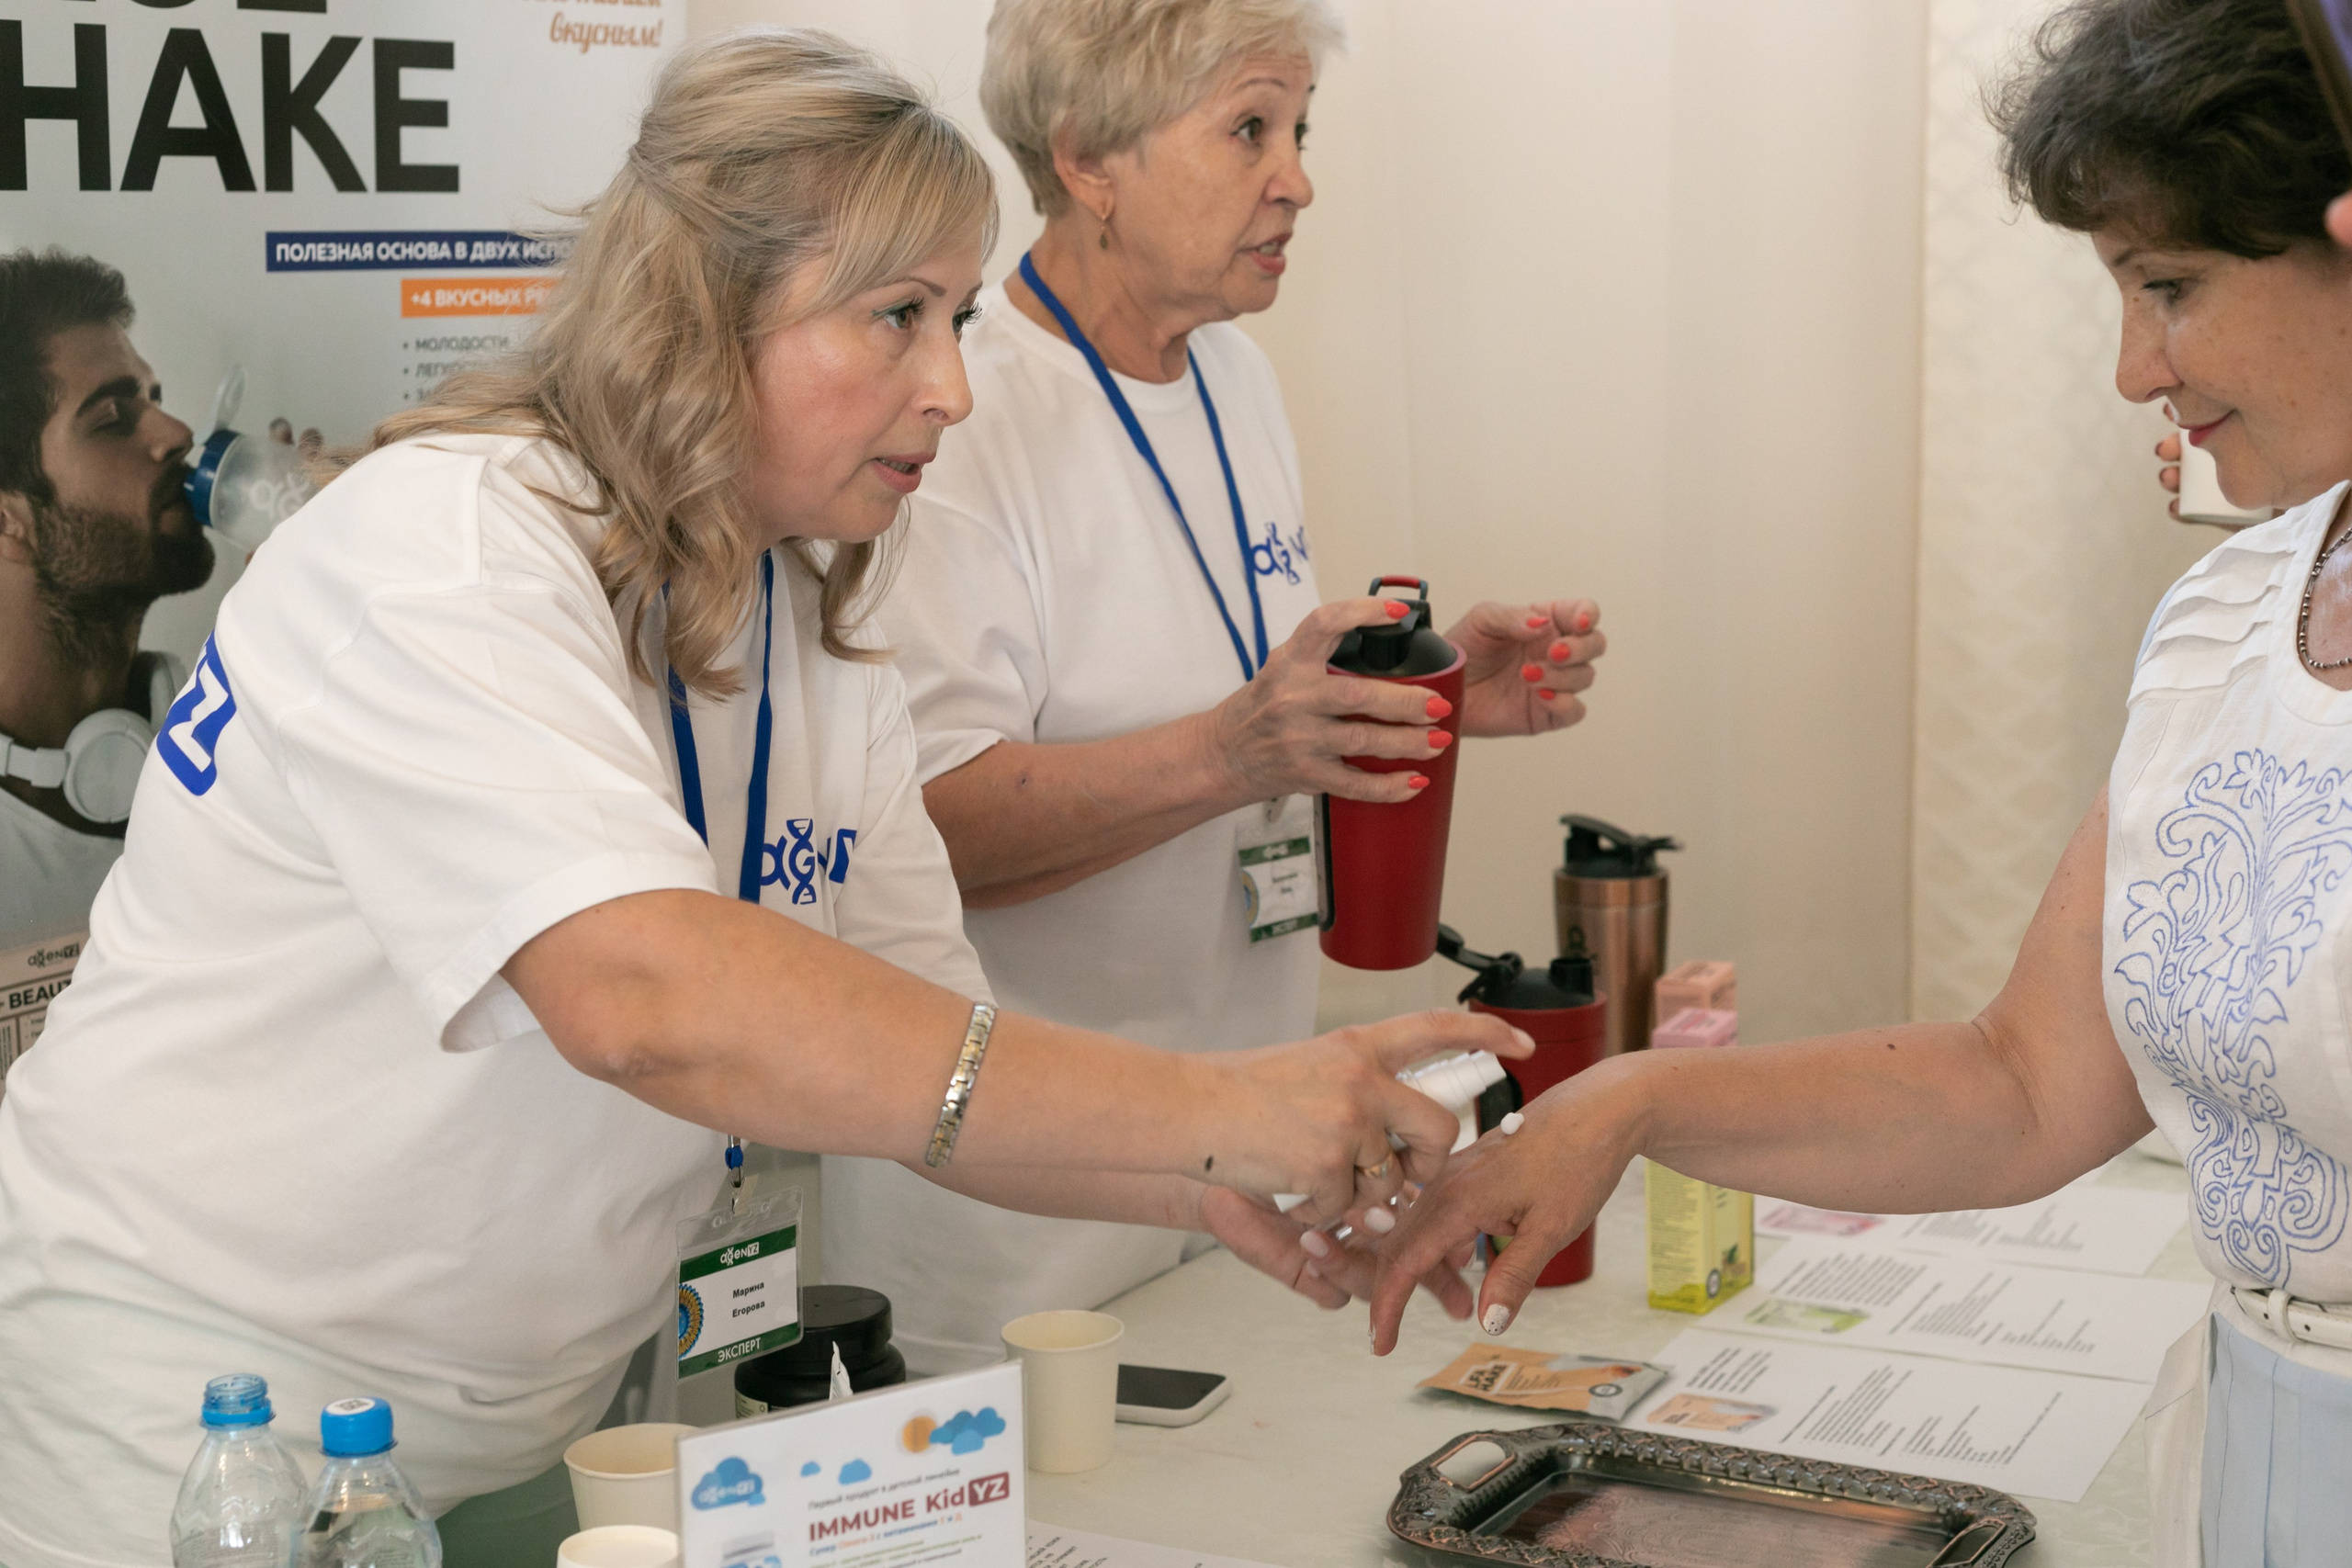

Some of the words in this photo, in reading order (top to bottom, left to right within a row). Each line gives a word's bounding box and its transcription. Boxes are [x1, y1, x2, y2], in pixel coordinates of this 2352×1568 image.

[0, 19, 460, 194] HAKE
[276, 242, 374, 263] ПОЛЕЗНАЯ
[377, 241, 452, 261] ОСНОВА
[454, 241, 468, 260] В
[469, 241, 520, 264] ДВУХ
[411, 290, 432, 307] +4
[435, 288, 521, 308] ВКУСНЫХ
[415, 335, 508, 351] МОЛОДОСТИ
[733, 1282, 764, 1299] Марина
[732, 1301, 765, 1317] Егорова
[718, 1337, 761, 1362] ЭКСПЕРТ
[809, 1499, 915, 1541] IMMUNE
